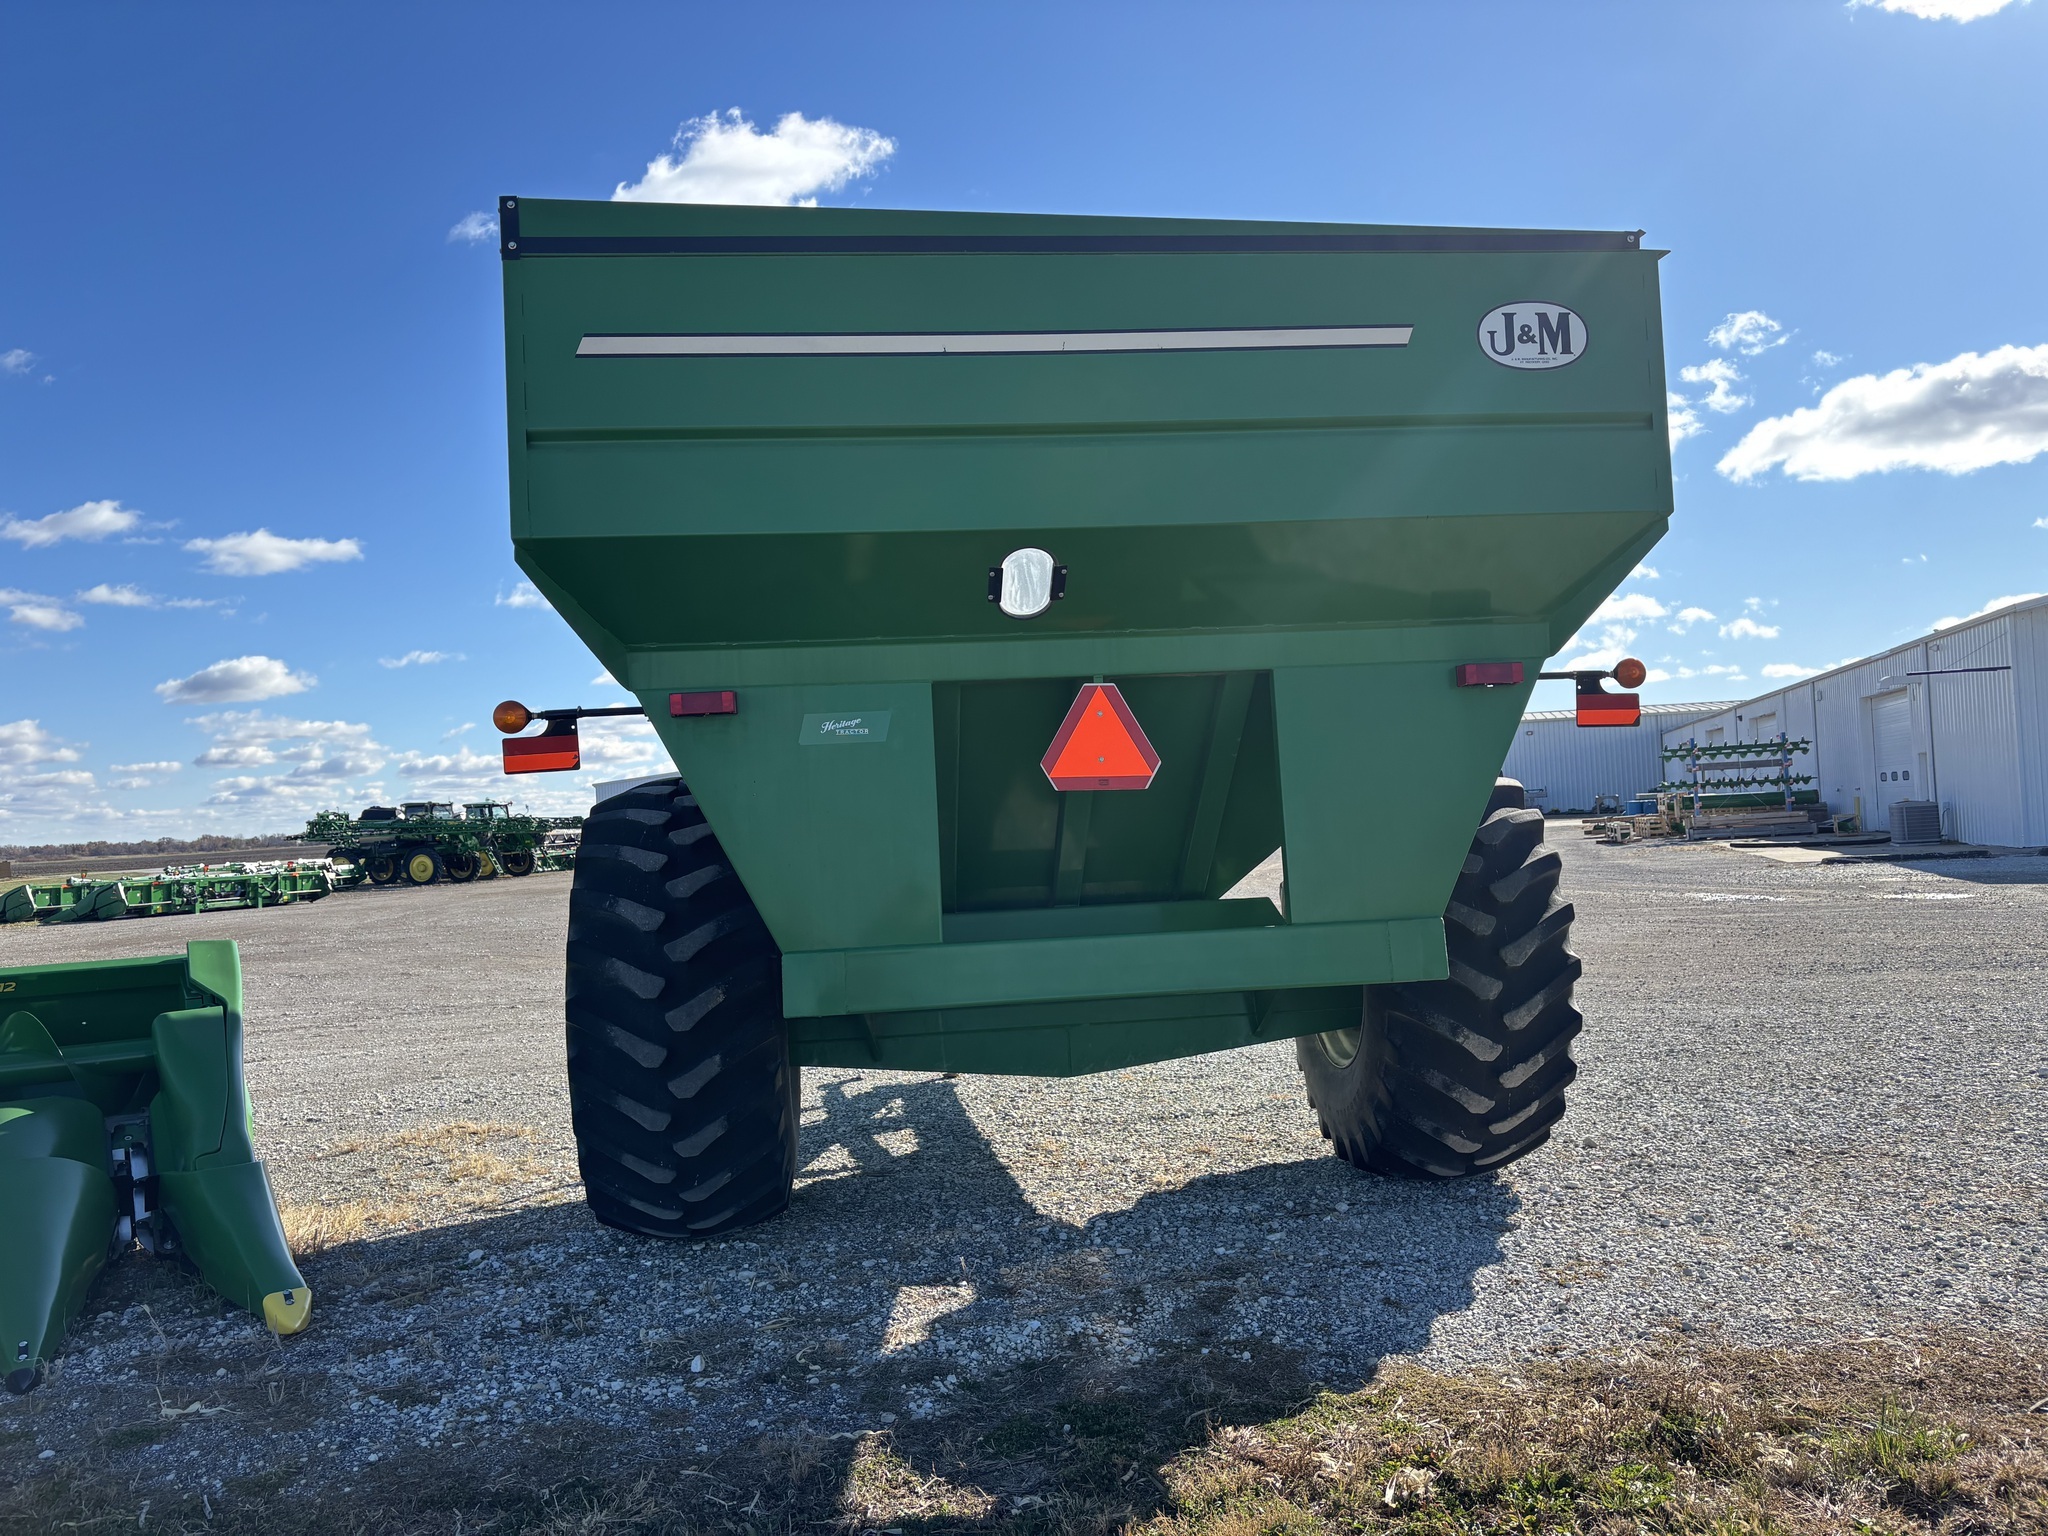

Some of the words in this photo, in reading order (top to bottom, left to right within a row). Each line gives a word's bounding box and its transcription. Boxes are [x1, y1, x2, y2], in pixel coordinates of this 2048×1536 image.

[1487, 312, 1574, 356] J&M
[820, 717, 862, 734] Heritage
[836, 728, 869, 736] TRACTOR
